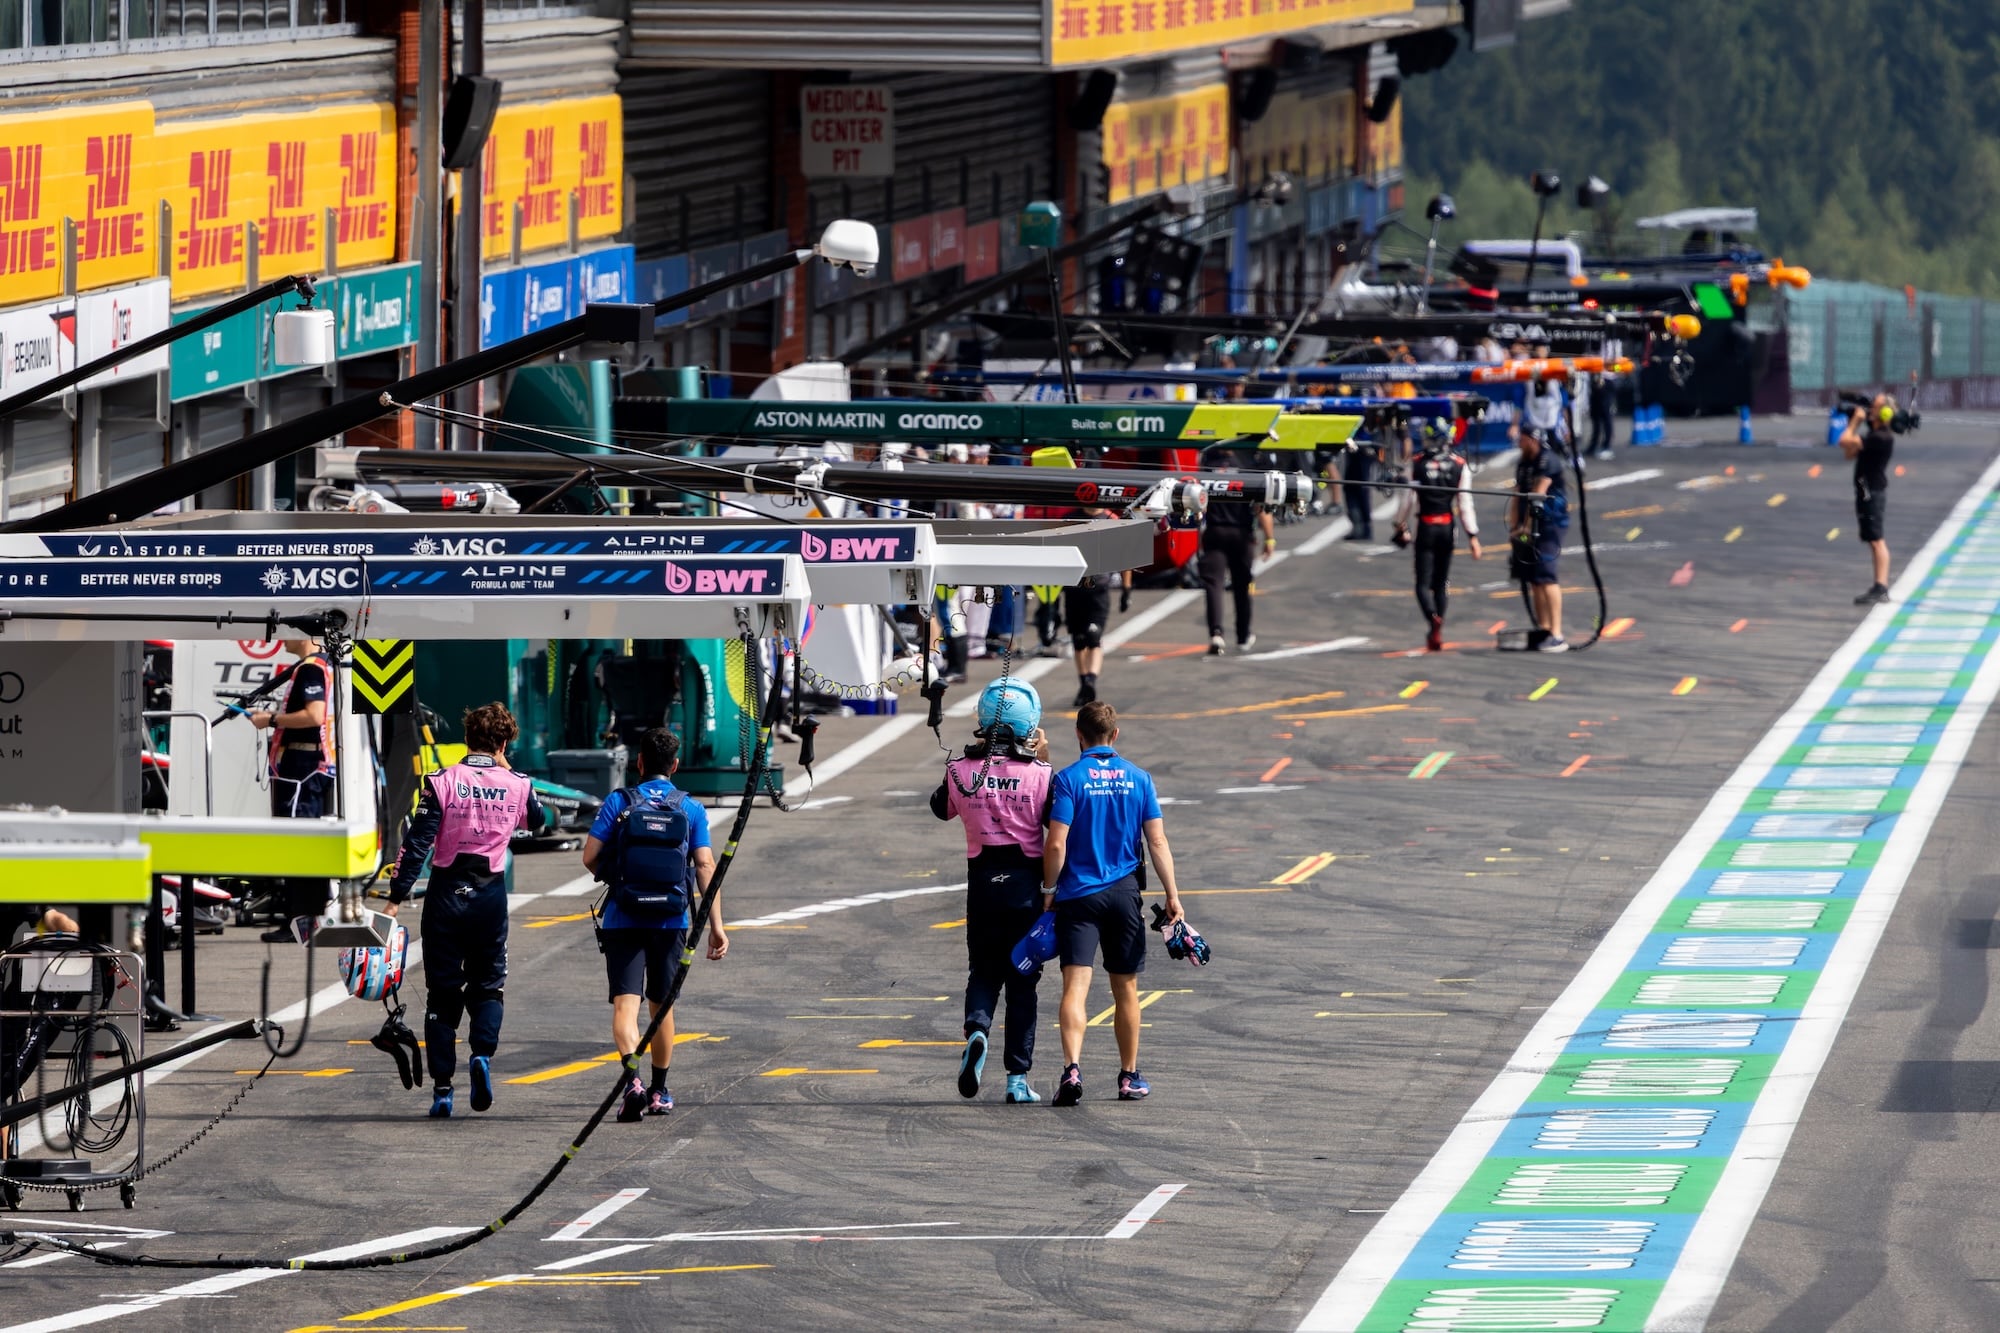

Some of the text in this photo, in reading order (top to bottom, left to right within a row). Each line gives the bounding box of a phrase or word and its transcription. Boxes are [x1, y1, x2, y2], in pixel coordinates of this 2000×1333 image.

[805, 90, 888, 113] MEDICAL
[811, 118, 883, 143] CENTER
[832, 149, 864, 172] PIT
[15, 337, 52, 374] BEARMAN
[754, 411, 984, 430] ASTON MARTIN aramco
[1071, 416, 1165, 433] Built on arm
[1098, 486, 1138, 497] TGR
[1200, 480, 1245, 491] TGR
[109, 535, 900, 560] CASTORE BETTER NEVER STOPS MSC ALPINE BWT
[80, 574, 129, 586] BETTER
[133, 574, 175, 585] NEVER
[179, 573, 222, 585] STOPS
[291, 568, 360, 590] MSC
[461, 566, 566, 577] ALPINE
[695, 569, 768, 593] BWT
[471, 580, 508, 589] FORMULA
[534, 580, 555, 589] TEAM
[1101, 769, 1126, 779] BWT
[987, 776, 1020, 791] BWT
[1083, 781, 1135, 790] ALPINE
[472, 786, 507, 801] BWT
[962, 793, 1032, 804] ALPINE
[446, 802, 517, 813] ALPINE
